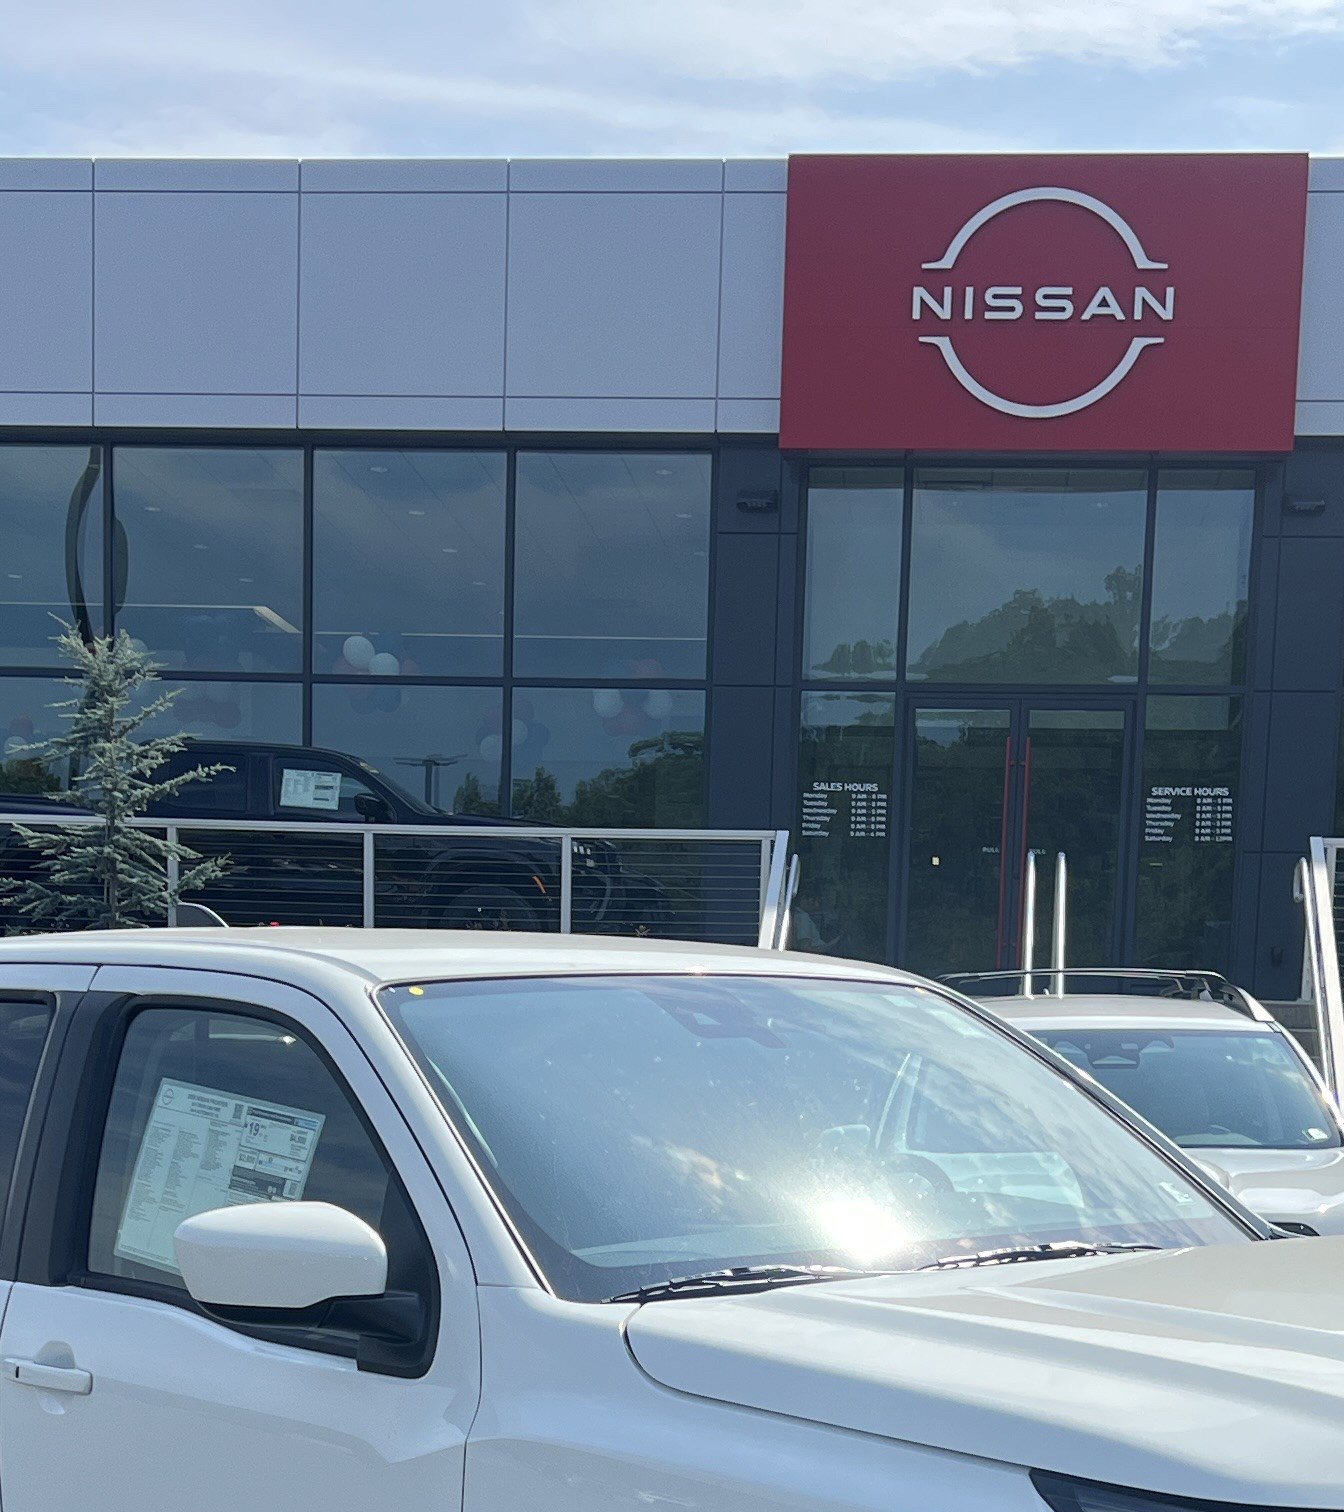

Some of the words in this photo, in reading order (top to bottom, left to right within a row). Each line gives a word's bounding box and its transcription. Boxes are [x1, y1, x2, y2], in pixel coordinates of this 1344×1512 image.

[911, 285, 1175, 321] NISSAN
[813, 782, 842, 791] SALES
[844, 783, 879, 792] HOURS
[1152, 787, 1192, 796] SERVICE
[1194, 787, 1229, 796] HOURS
